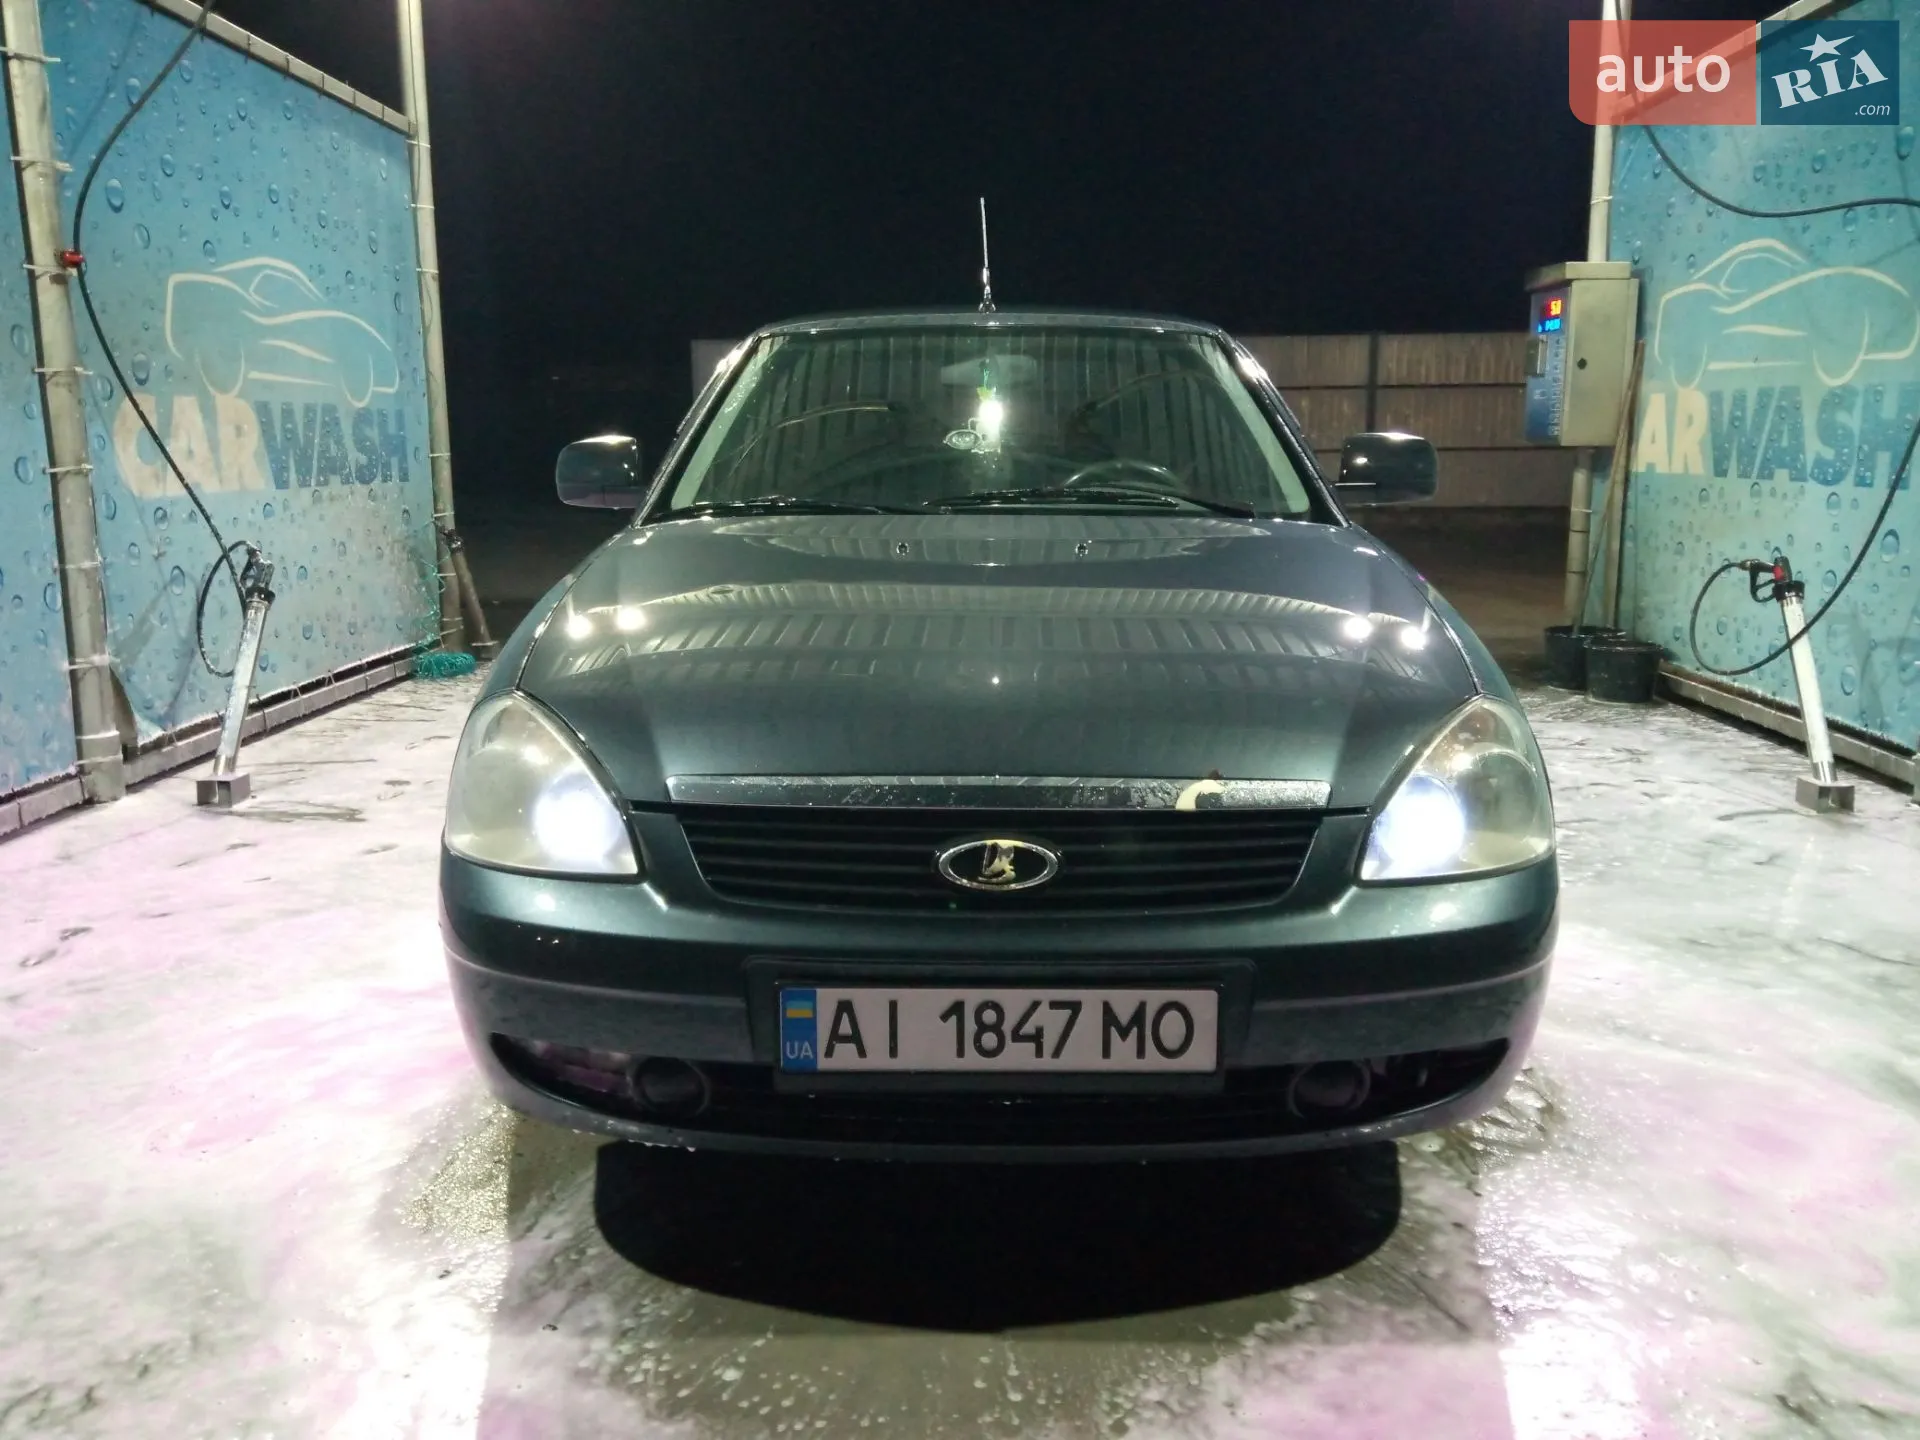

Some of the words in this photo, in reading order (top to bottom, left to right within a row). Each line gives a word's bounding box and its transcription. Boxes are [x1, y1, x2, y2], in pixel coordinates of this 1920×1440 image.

[824, 999, 899, 1060] AI
[939, 1000, 1083, 1060] 1847
[1102, 1000, 1195, 1060] MO
[786, 1040, 814, 1060] UA
